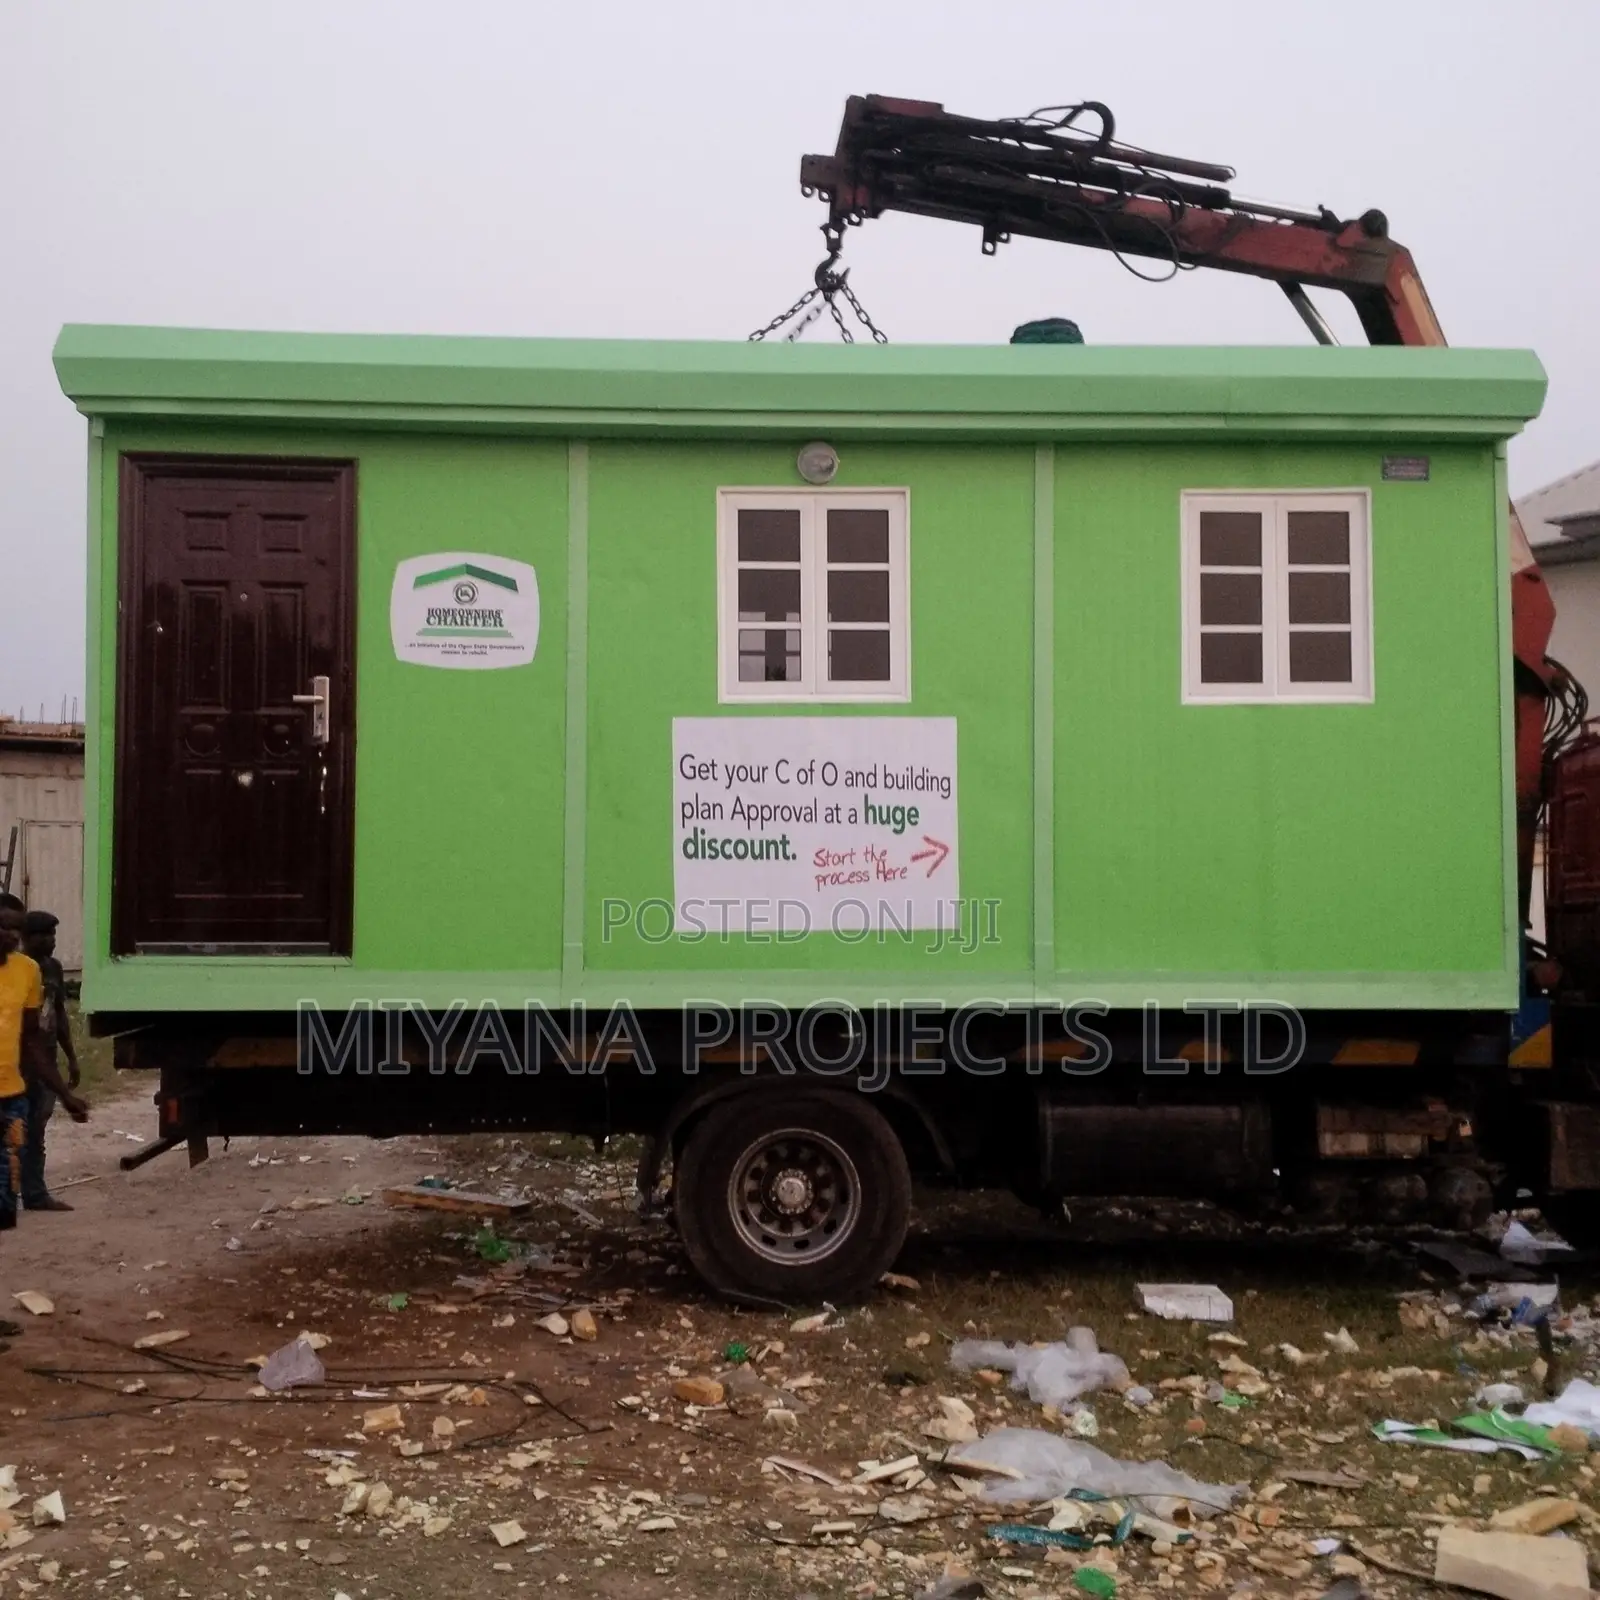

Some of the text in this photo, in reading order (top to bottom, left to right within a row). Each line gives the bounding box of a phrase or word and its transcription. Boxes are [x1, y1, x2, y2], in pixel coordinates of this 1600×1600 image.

[426, 614, 504, 628] CHARTER
[679, 754, 951, 798] Get your C of O and building
[681, 793, 920, 834] plan Approval at a huge
[682, 827, 797, 860] discount.
[813, 844, 888, 868] Start the
[814, 860, 908, 892] process Here
